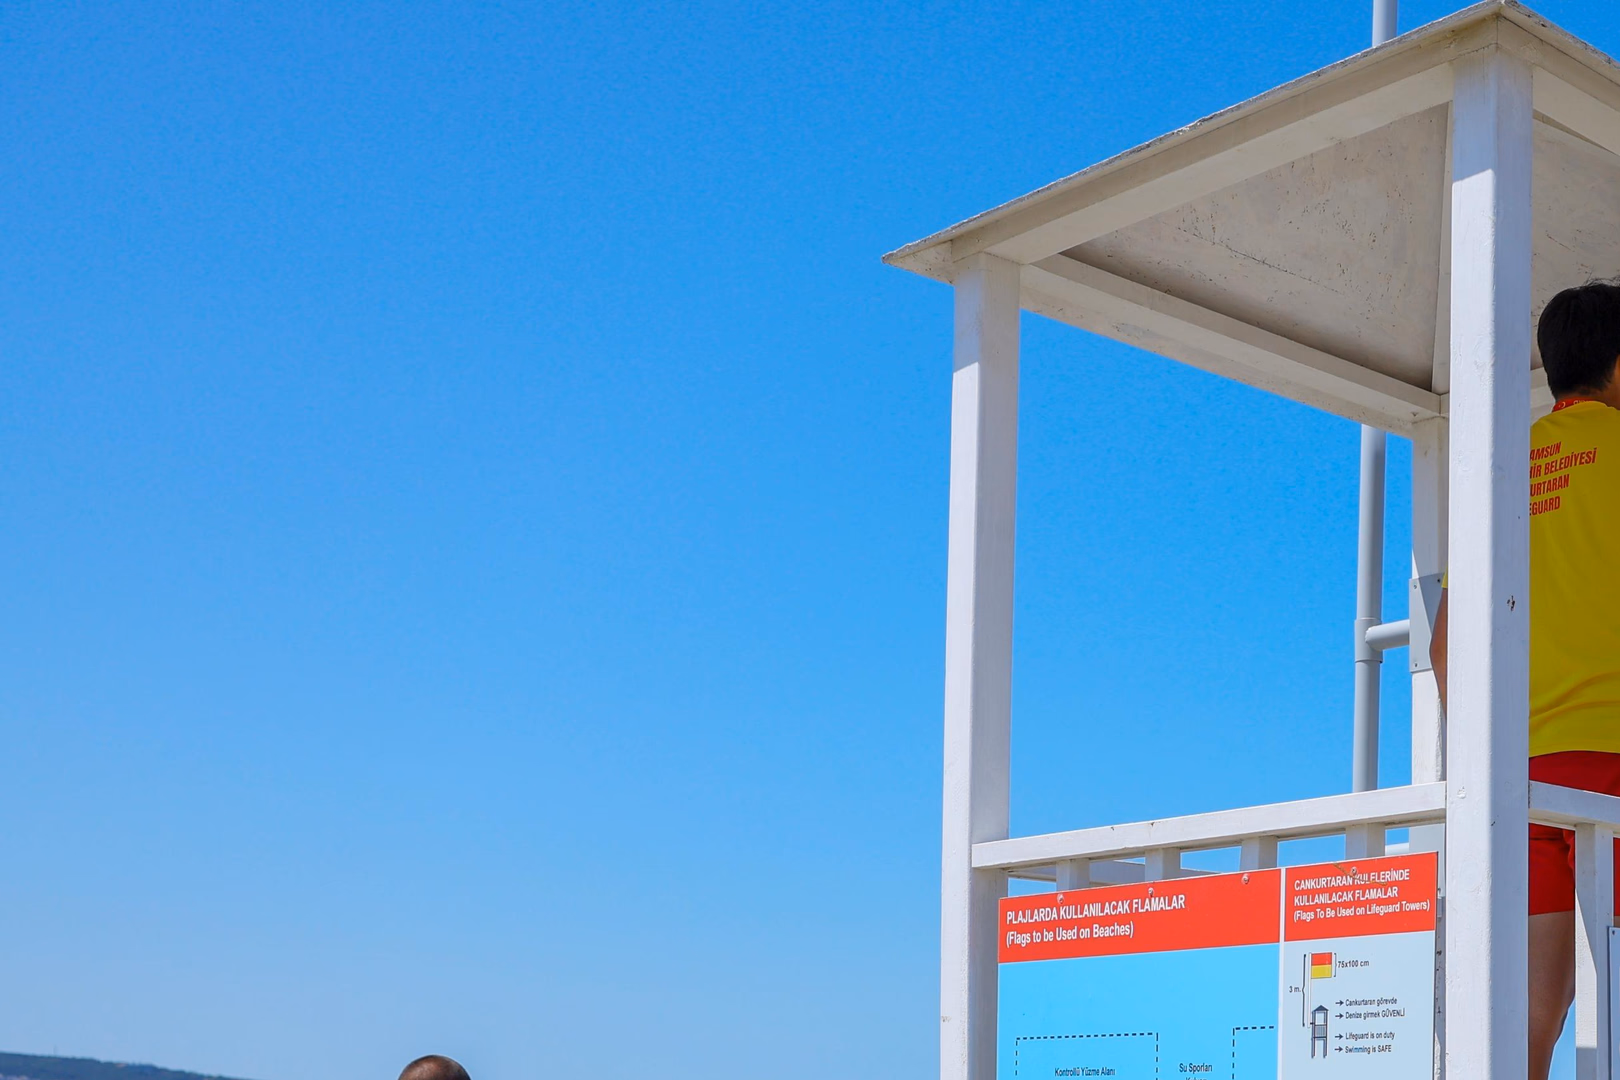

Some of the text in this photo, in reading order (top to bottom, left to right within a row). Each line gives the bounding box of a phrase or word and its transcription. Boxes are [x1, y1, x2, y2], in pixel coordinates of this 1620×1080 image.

[1529, 441, 1561, 461] AMSUN
[1544, 447, 1597, 476] BELEDİYESİ
[1529, 474, 1570, 497] URTARAN
[1529, 496, 1561, 516] GUARD
[1294, 875, 1353, 891] CANKURTARAN
[1294, 886, 1399, 906] KULLANILACAK FLAMALAR
[1006, 894, 1186, 925] PLAJLARDA KULLANILACAK FLAMALAR
[1293, 899, 1430, 923] (Flags To Be Used on Lifeguard Towers)
[1006, 921, 1134, 948] (Flags to be Used on Beaches)
[1338, 959, 1359, 968] 75x100
[1289, 985, 1293, 993] 3
[1345, 998, 1376, 1007] Cankurtaran
[1345, 1011, 1362, 1019] Denize
[1363, 1010, 1380, 1020] girmek
[1345, 1032, 1369, 1041] Lifeguard
[1383, 1031, 1395, 1040] duty
[1345, 1046, 1371, 1055] Swimming
[1377, 1044, 1392, 1053] SAFE
[1179, 1063, 1187, 1073] Su
